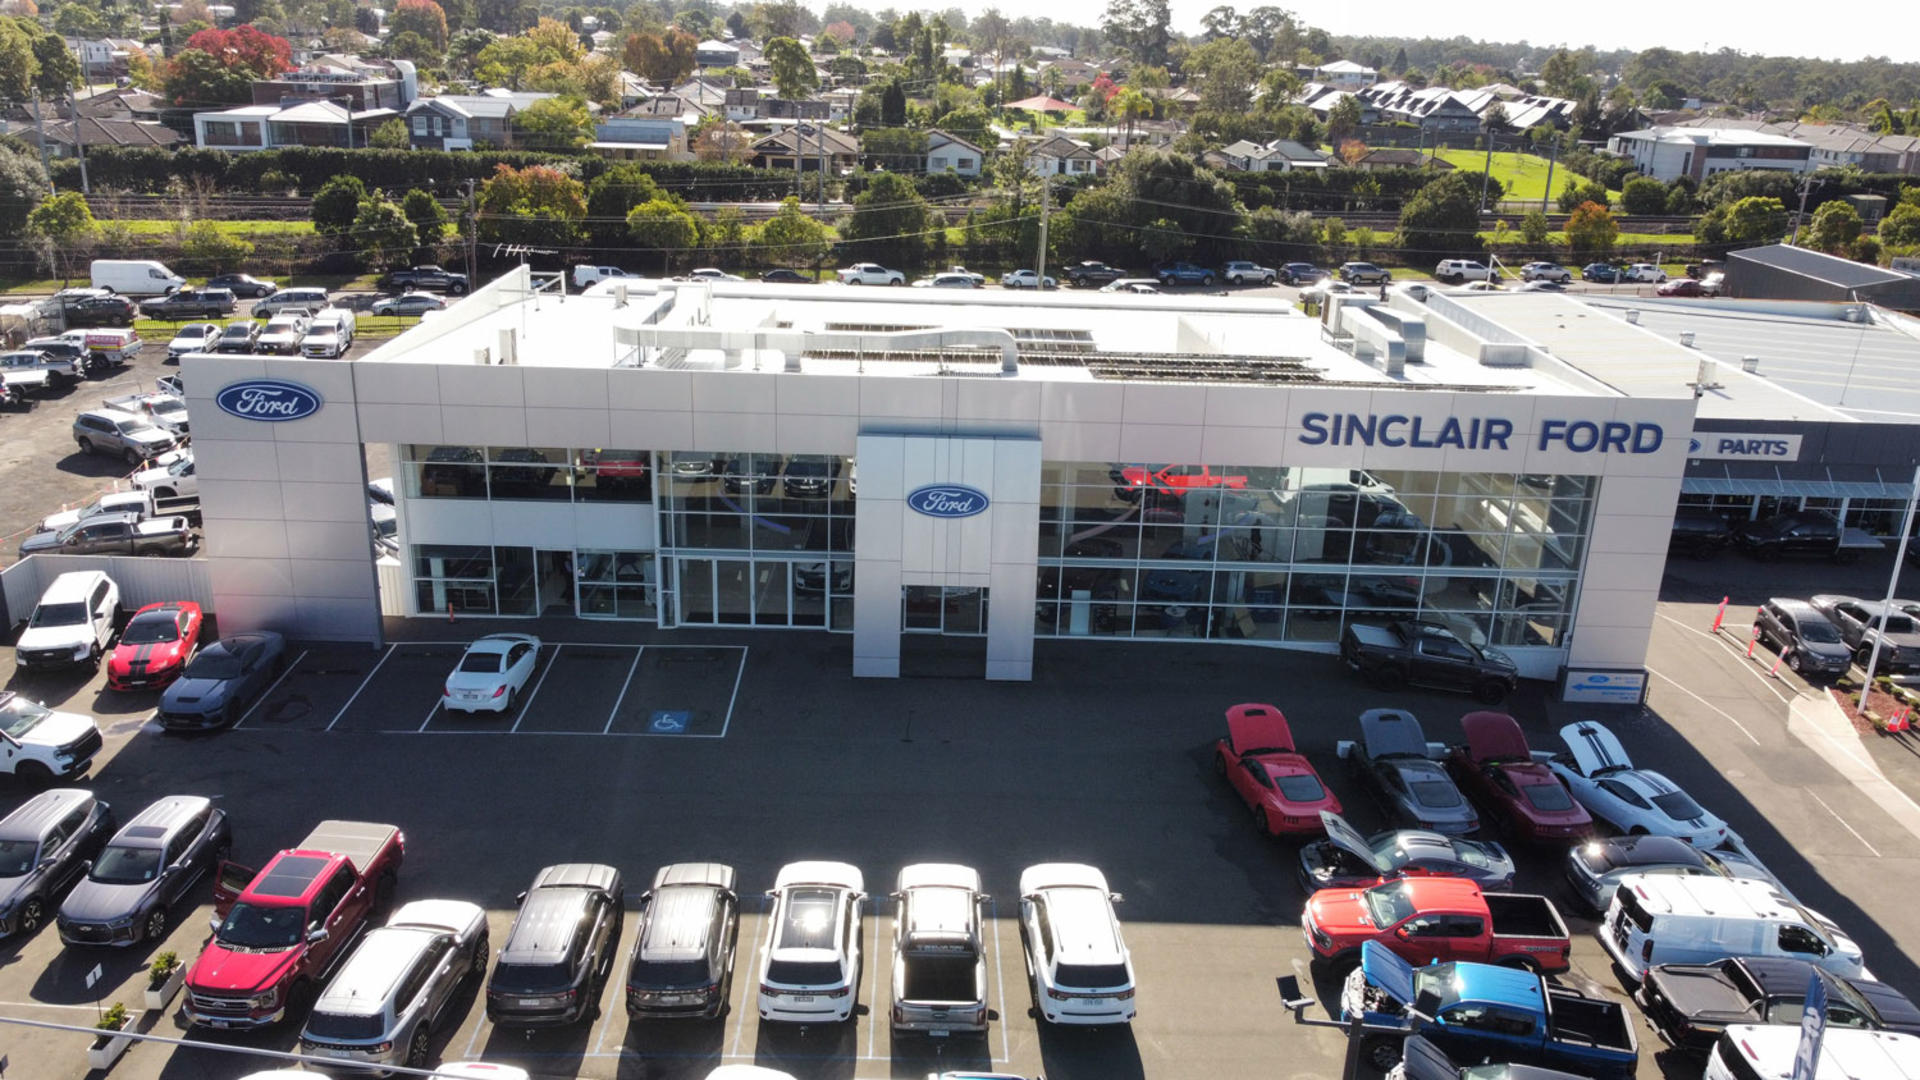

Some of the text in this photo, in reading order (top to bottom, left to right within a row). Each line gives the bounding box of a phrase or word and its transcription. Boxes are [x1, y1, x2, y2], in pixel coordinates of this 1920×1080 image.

[236, 388, 299, 415] Ford
[1298, 412, 1664, 454] SINCLAIR FORD
[1717, 438, 1789, 456] PARTS
[923, 490, 973, 512] Ford
